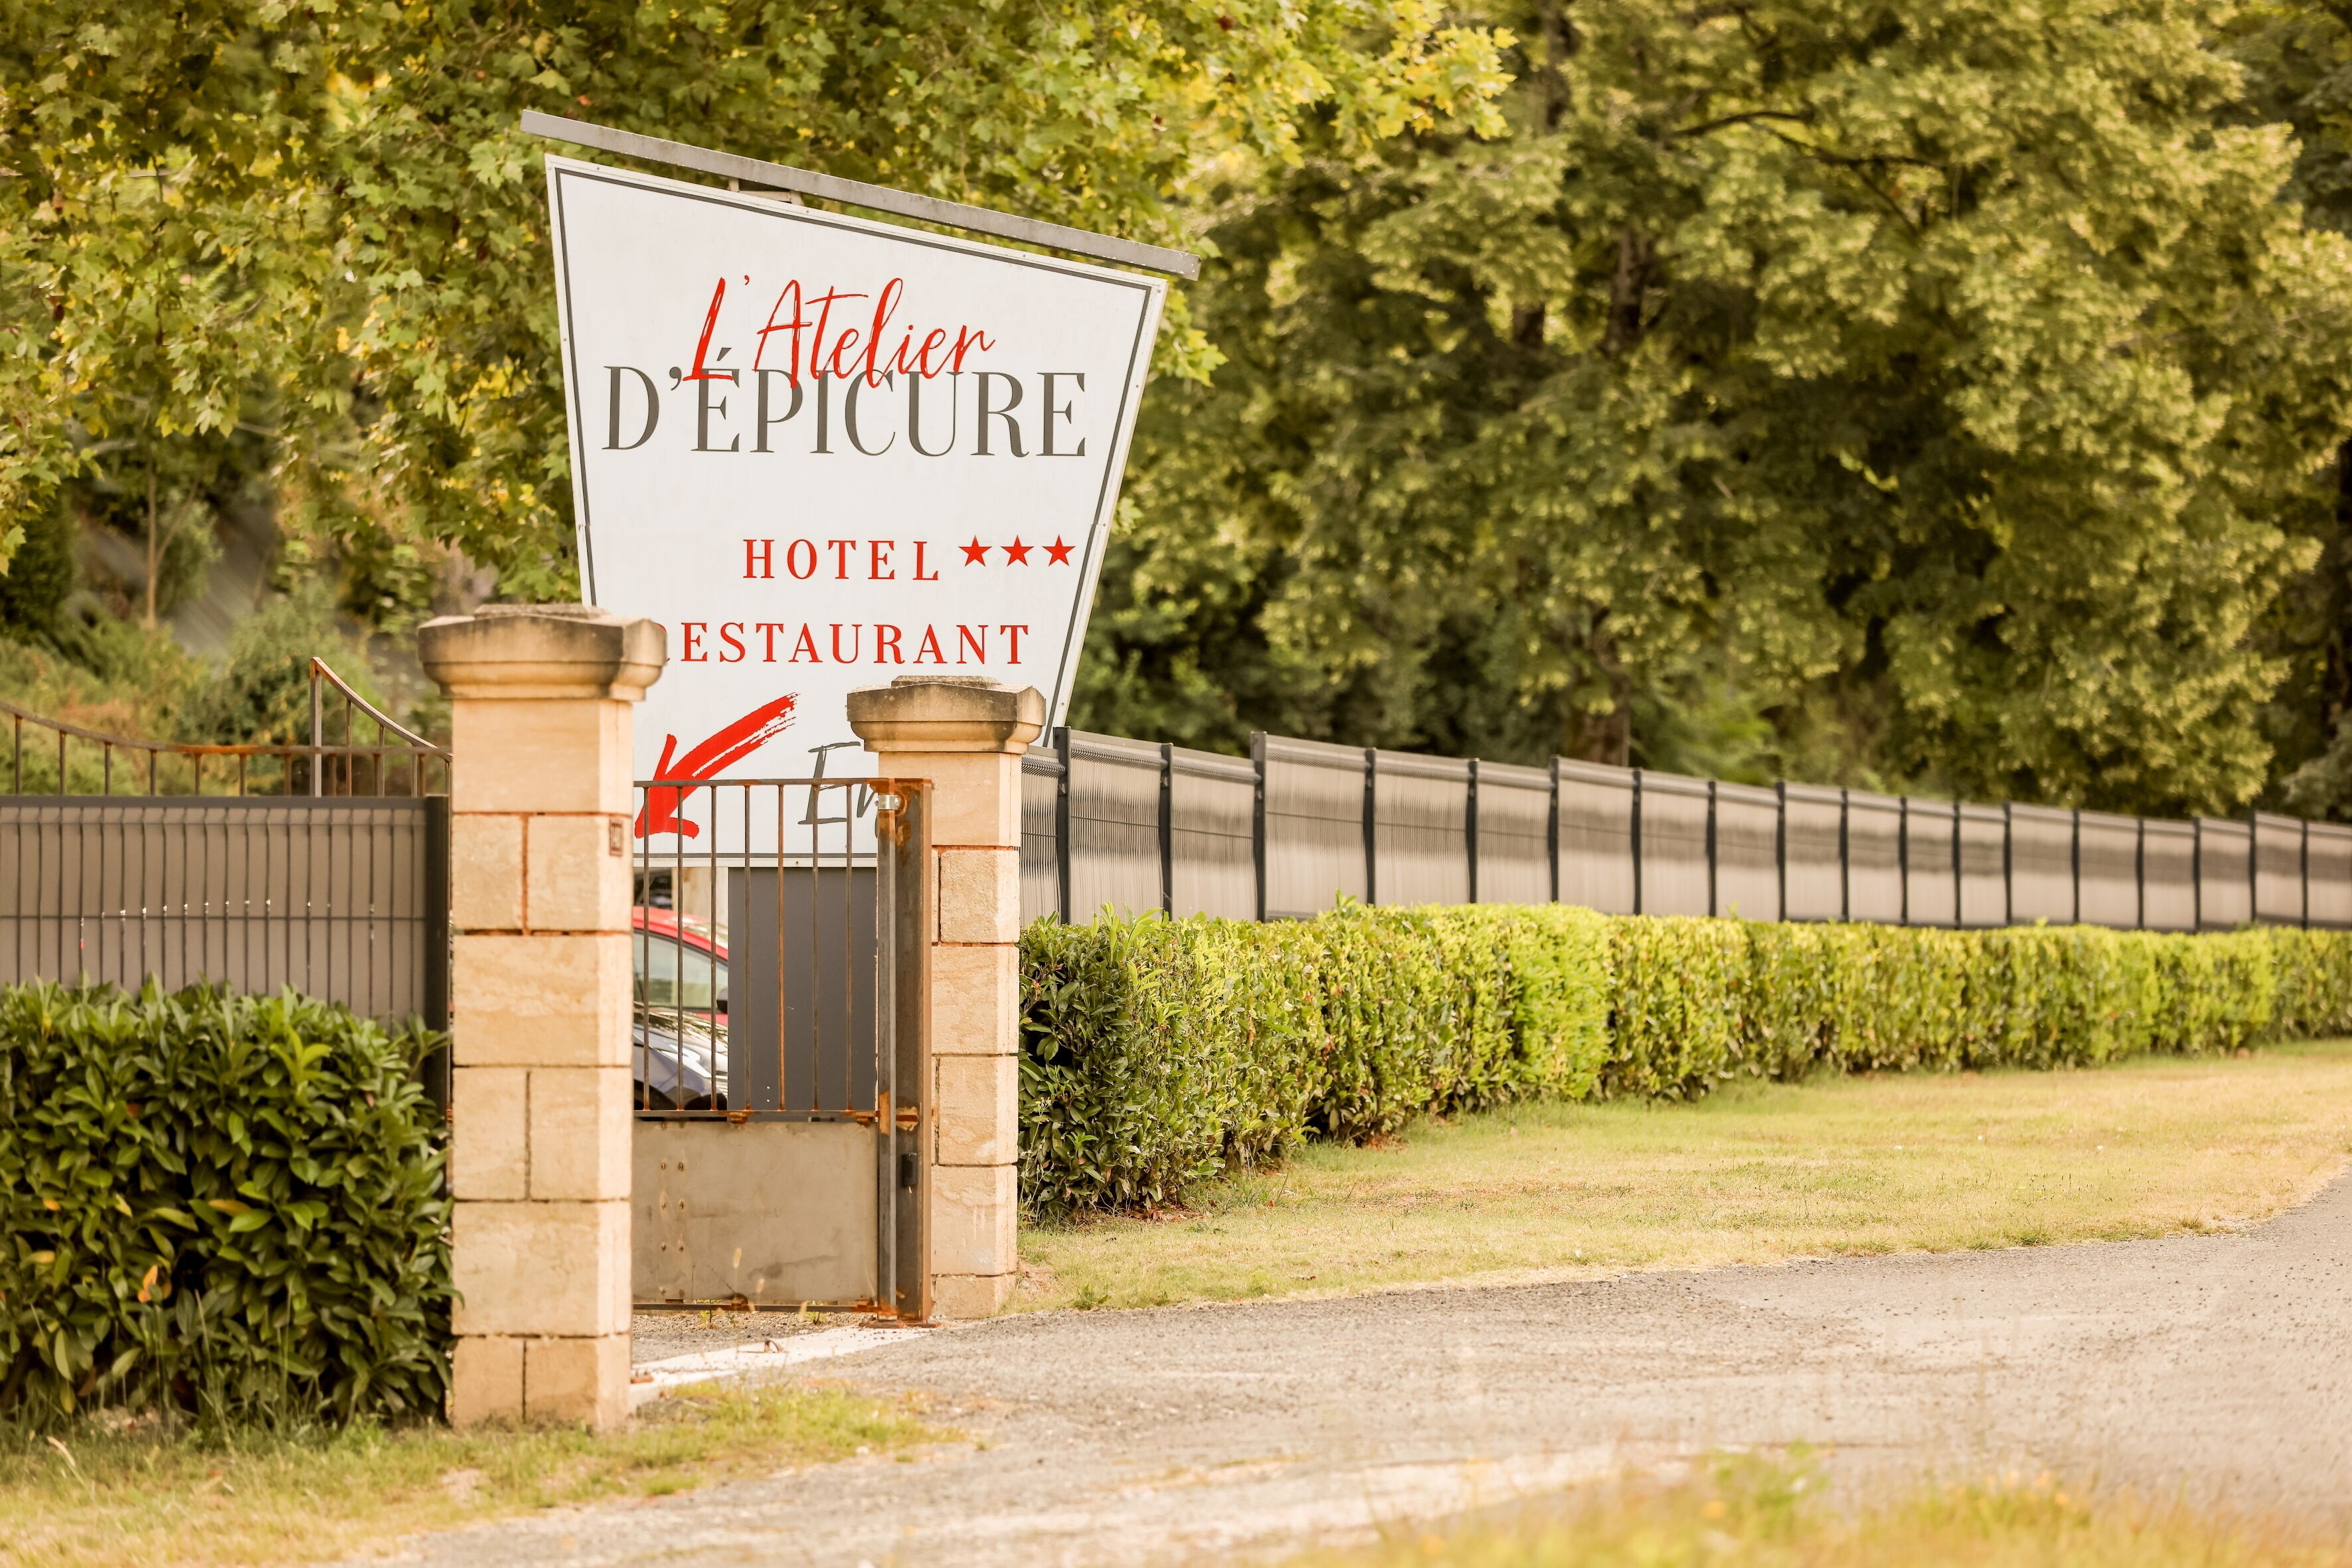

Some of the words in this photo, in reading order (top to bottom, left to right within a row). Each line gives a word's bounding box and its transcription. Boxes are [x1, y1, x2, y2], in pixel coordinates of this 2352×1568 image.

[682, 275, 995, 390] L'Atelier
[602, 347, 1086, 458] D'ÉPICURE
[743, 538, 940, 581] HOTEL
[663, 621, 1029, 665] ESTAURANT
